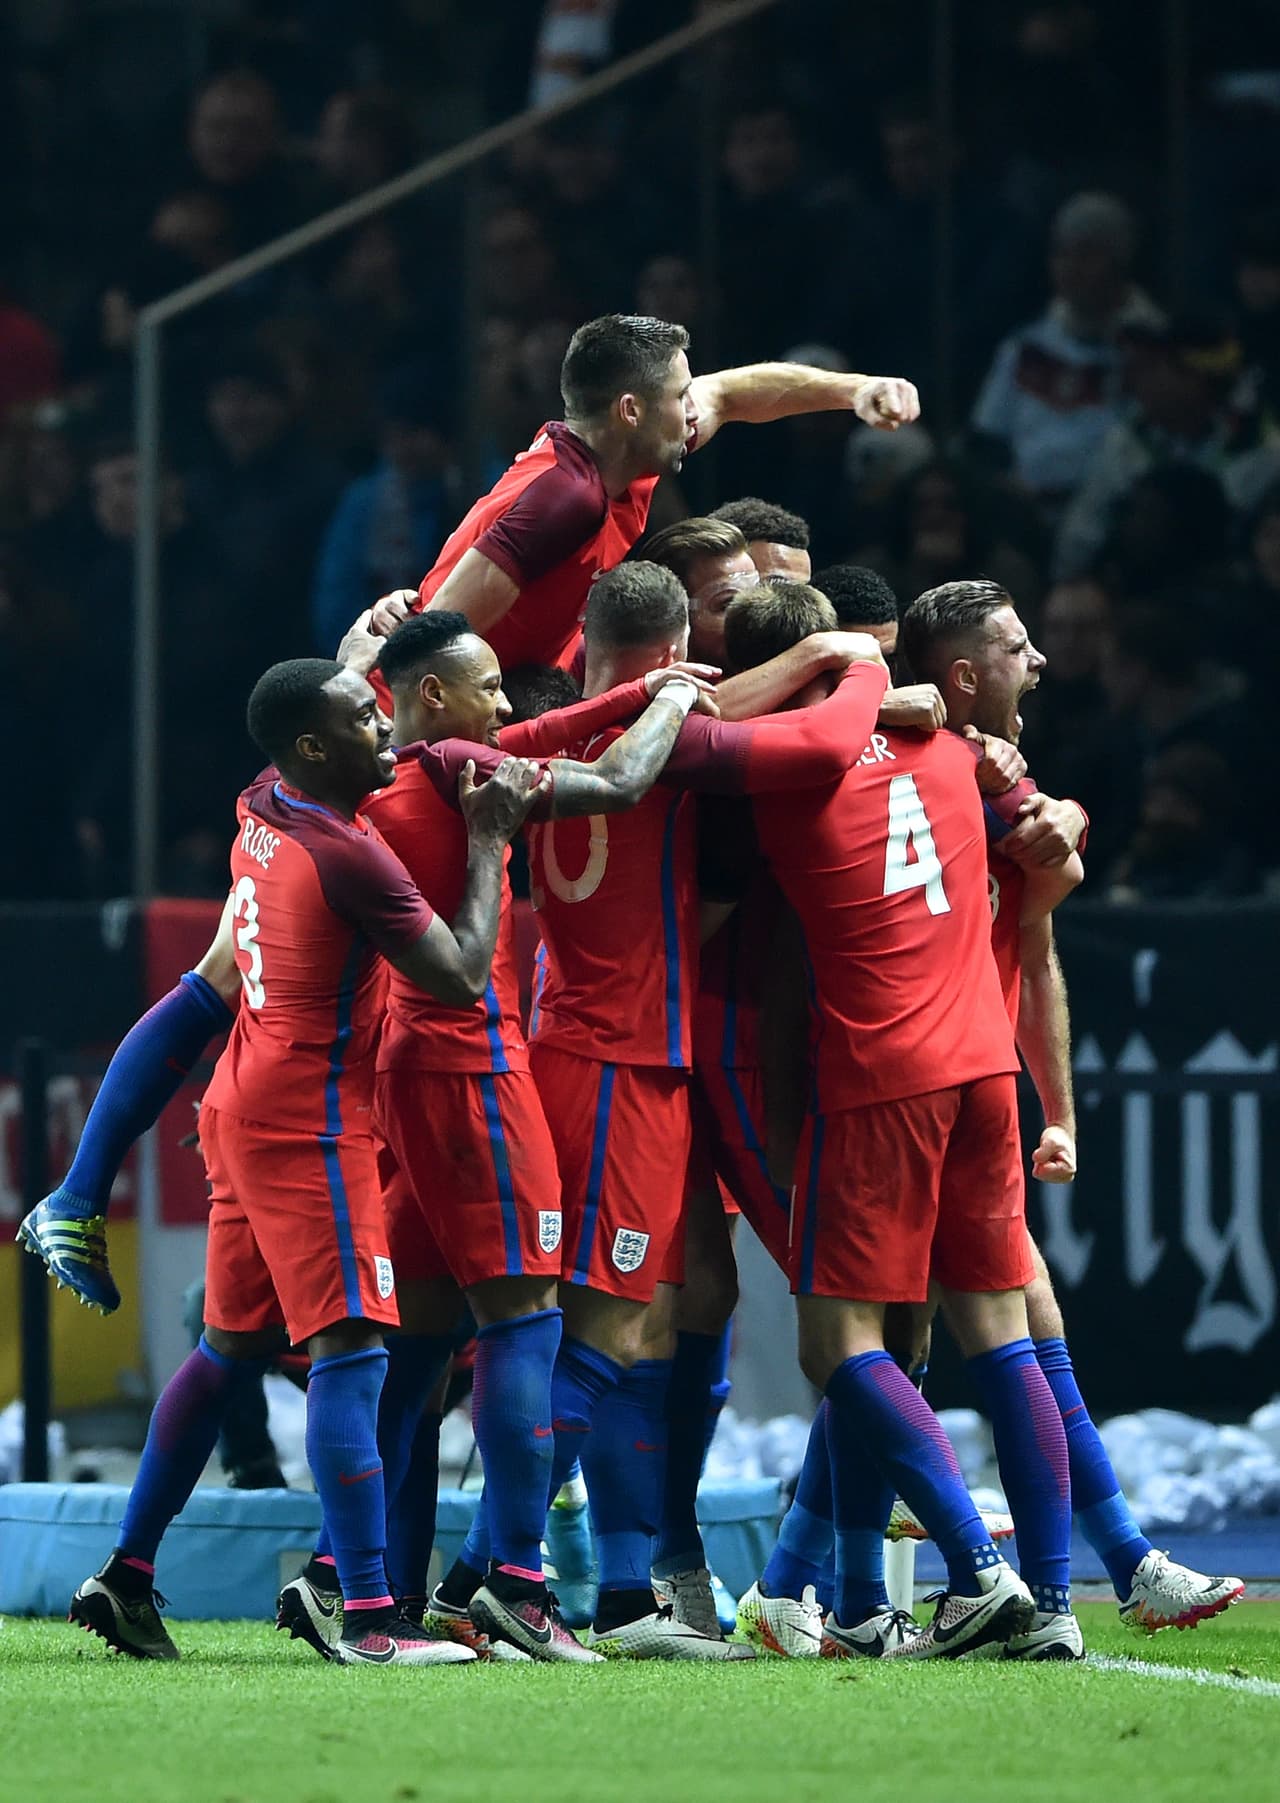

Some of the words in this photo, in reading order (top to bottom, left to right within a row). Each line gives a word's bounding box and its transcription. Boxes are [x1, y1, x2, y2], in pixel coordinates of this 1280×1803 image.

[856, 733, 896, 767] ER
[240, 817, 281, 870] ROSE
[883, 773, 951, 915] 4
[233, 875, 266, 1009] 3
